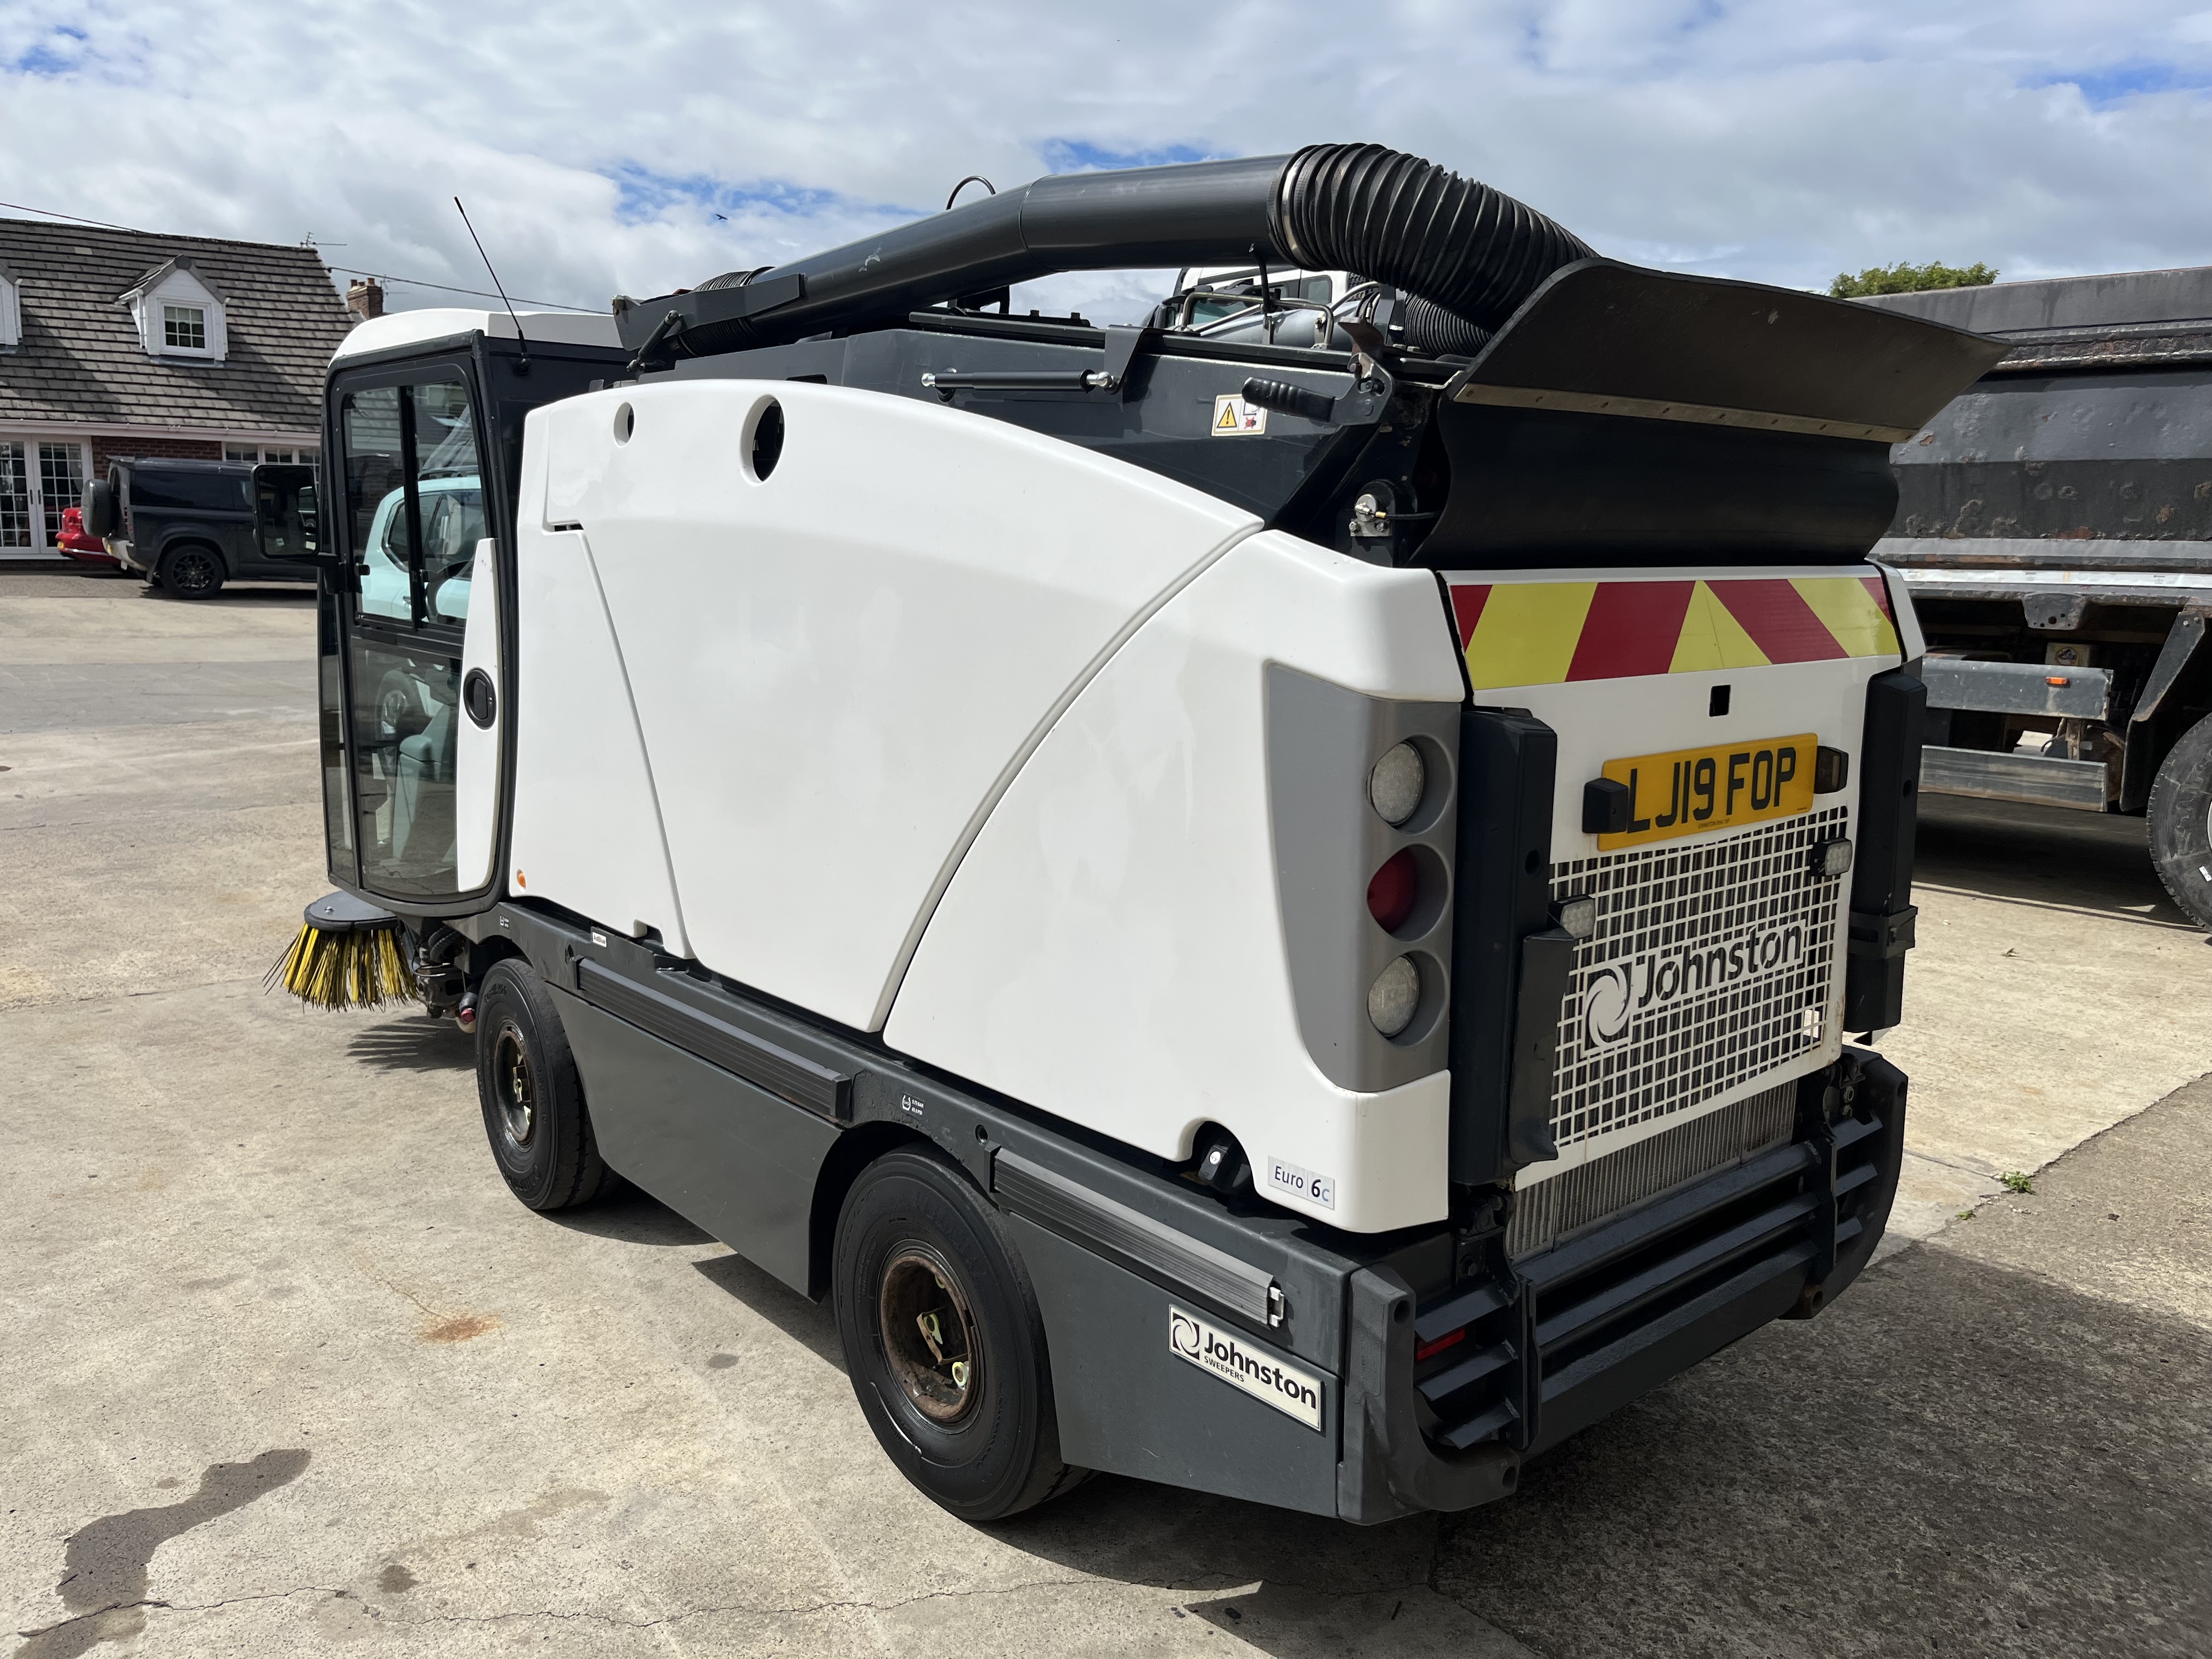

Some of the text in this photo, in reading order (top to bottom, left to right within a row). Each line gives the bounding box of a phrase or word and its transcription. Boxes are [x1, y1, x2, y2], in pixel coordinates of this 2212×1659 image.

[1627, 747, 1796, 833] LJ19 FOP
[1638, 925, 1802, 1008] Johnston
[1274, 1165, 1304, 1188] Euro
[1204, 1356, 1245, 1383] SWEEPERS
[1204, 1332, 1316, 1409] Johnston
